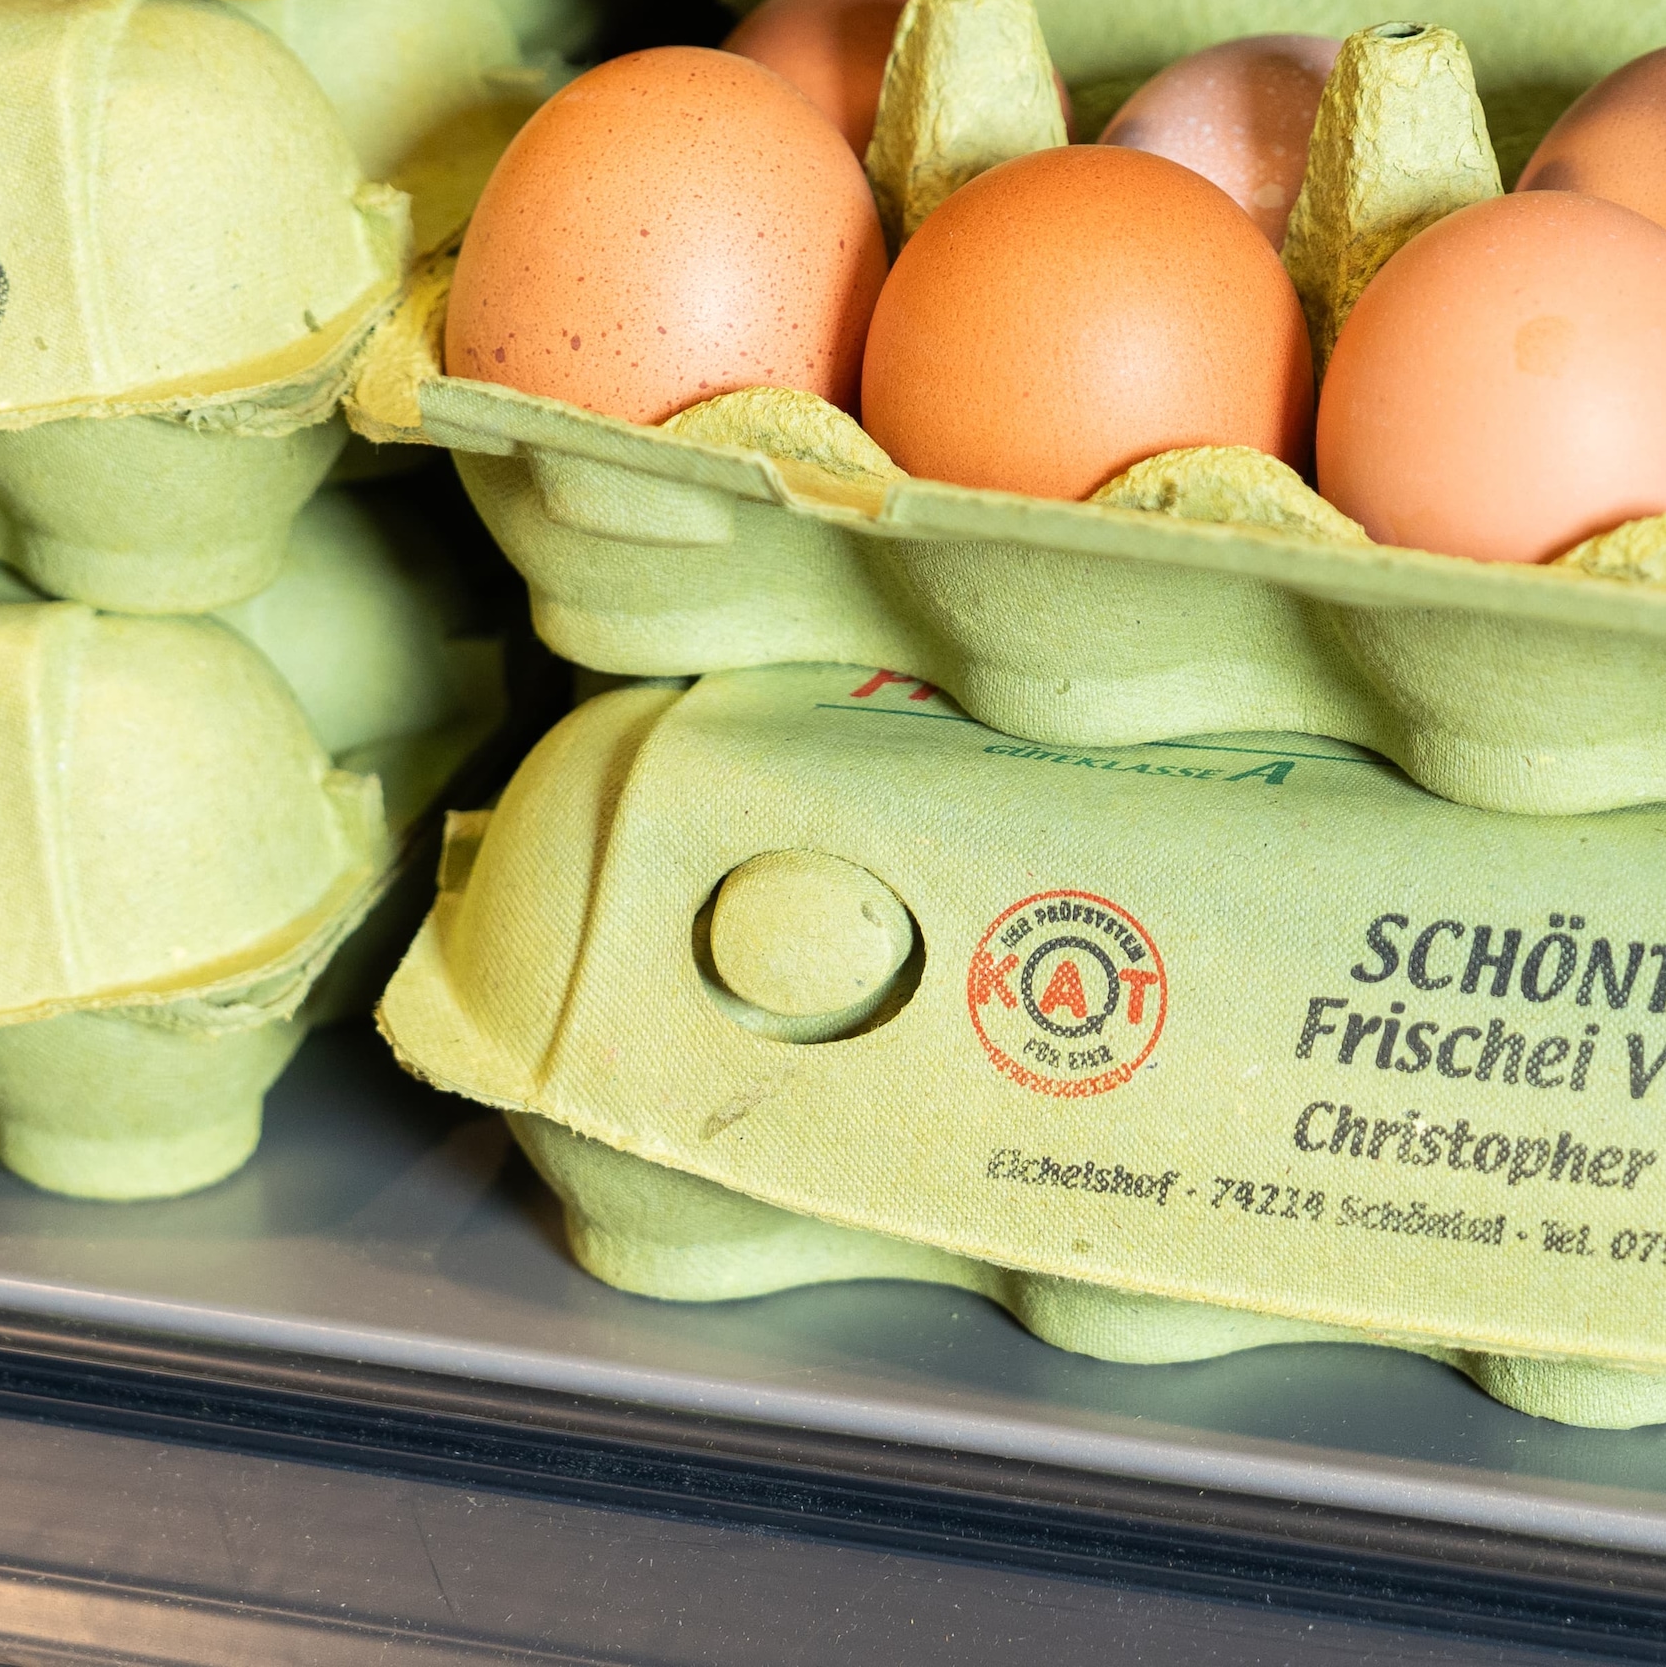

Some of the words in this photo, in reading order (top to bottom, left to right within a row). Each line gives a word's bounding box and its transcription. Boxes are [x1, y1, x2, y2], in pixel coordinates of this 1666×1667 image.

[984, 743, 1217, 783] GÜTEKLASSE
[1226, 760, 1297, 787] A
[975, 950, 1159, 1025] KAT
[1294, 994, 1601, 1094] Frischei
[1294, 1100, 1658, 1196] Christopher
[986, 1146, 1182, 1209] Eichelshof
[1209, 1177, 1327, 1227] 74214
[1337, 1192, 1505, 1250] Schöntal
